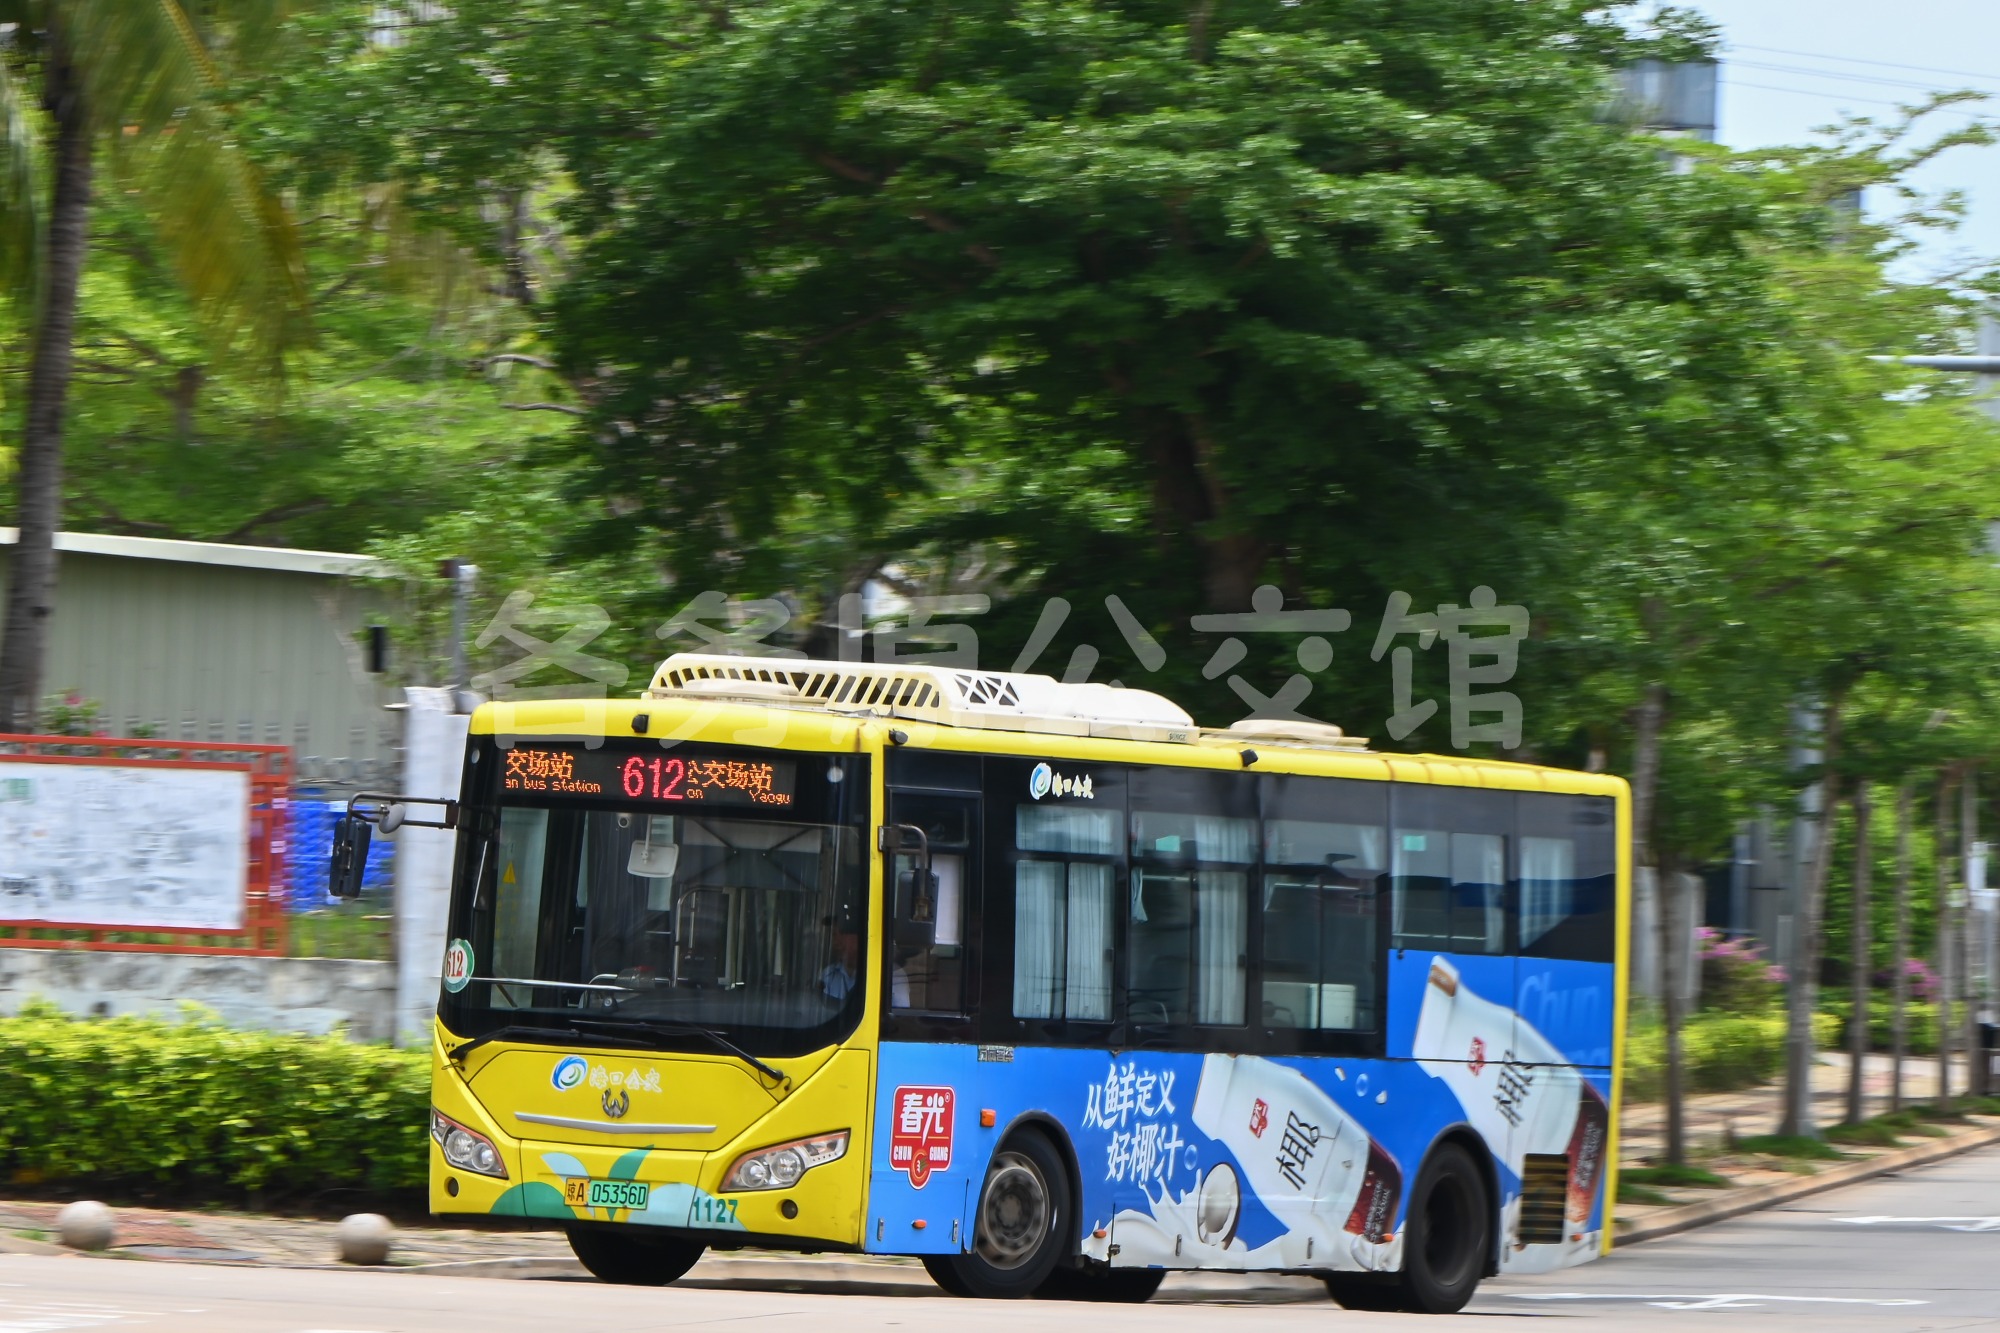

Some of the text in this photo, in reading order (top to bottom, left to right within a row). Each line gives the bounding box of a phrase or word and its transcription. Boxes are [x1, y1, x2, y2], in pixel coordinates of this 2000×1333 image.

[506, 748, 574, 780] 交场站
[623, 755, 685, 800] 612
[523, 776, 547, 791] bus
[552, 779, 602, 794] station
[446, 949, 464, 977] 612
[1081, 1061, 1176, 1131] 从鲜定义
[899, 1092, 946, 1147] 春光
[893, 1145, 949, 1162] CHUN GUANG
[1105, 1122, 1185, 1183] 好椰汁
[591, 1183, 648, 1206] 05356D
[692, 1196, 739, 1224] 1127
